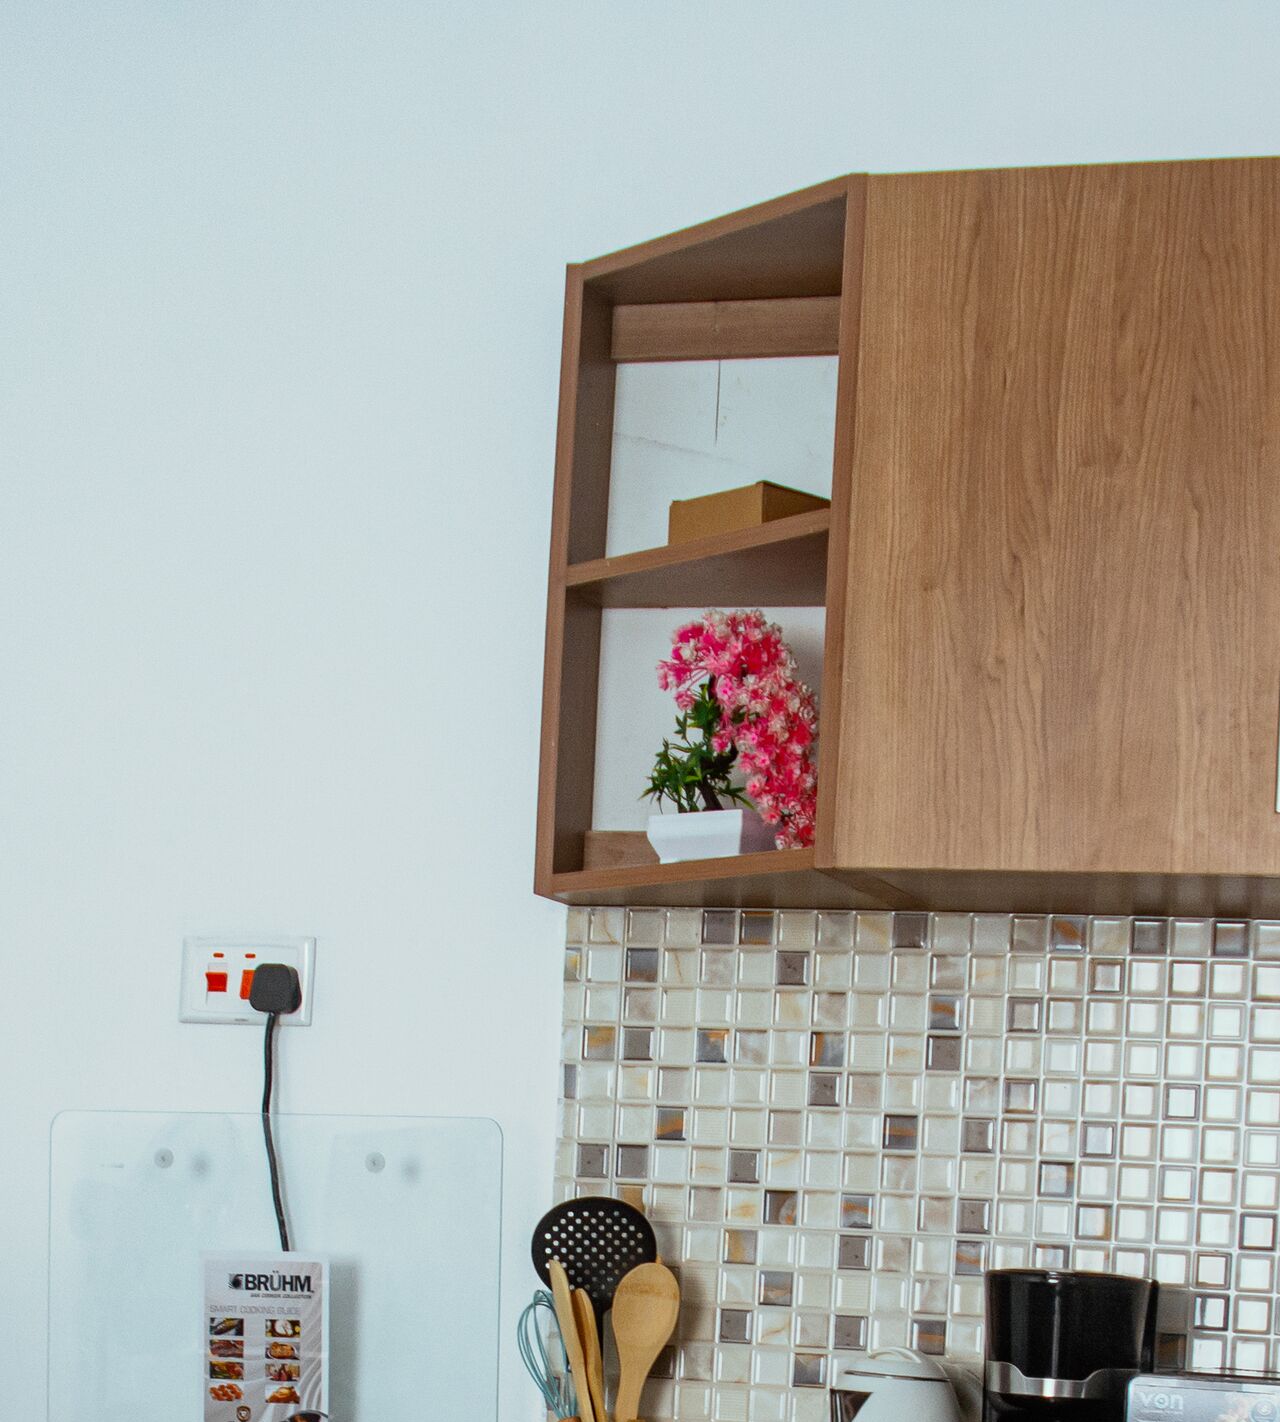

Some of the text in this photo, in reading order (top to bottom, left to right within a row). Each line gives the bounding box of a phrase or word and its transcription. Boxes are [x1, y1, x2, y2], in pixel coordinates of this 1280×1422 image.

[244, 1270, 312, 1293] BRÜHM
[209, 1304, 300, 1315] SMART COOKING GUIDE
[1136, 1391, 1183, 1410] von
